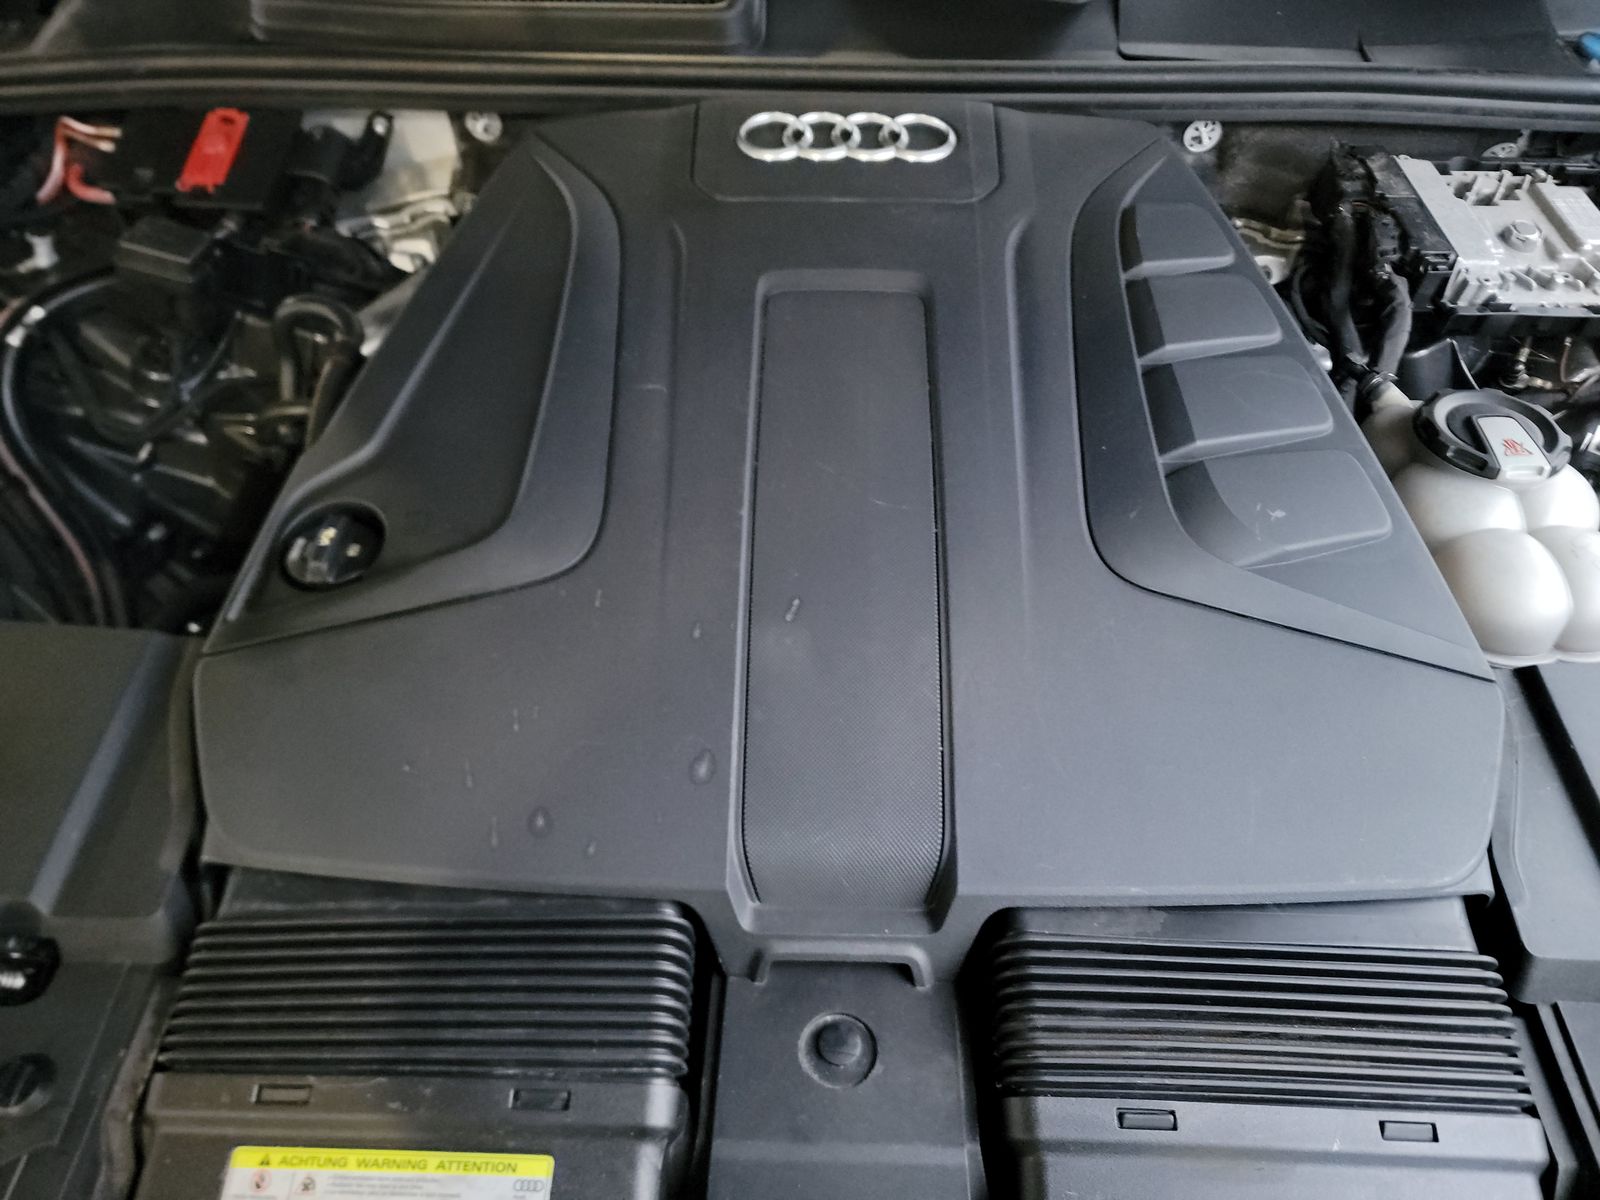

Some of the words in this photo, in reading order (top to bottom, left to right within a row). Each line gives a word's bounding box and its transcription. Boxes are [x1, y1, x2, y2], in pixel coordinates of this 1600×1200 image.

[278, 1156, 348, 1169] ACHTUNG
[356, 1158, 428, 1171] WARNING
[436, 1160, 518, 1173] ATTENTION
